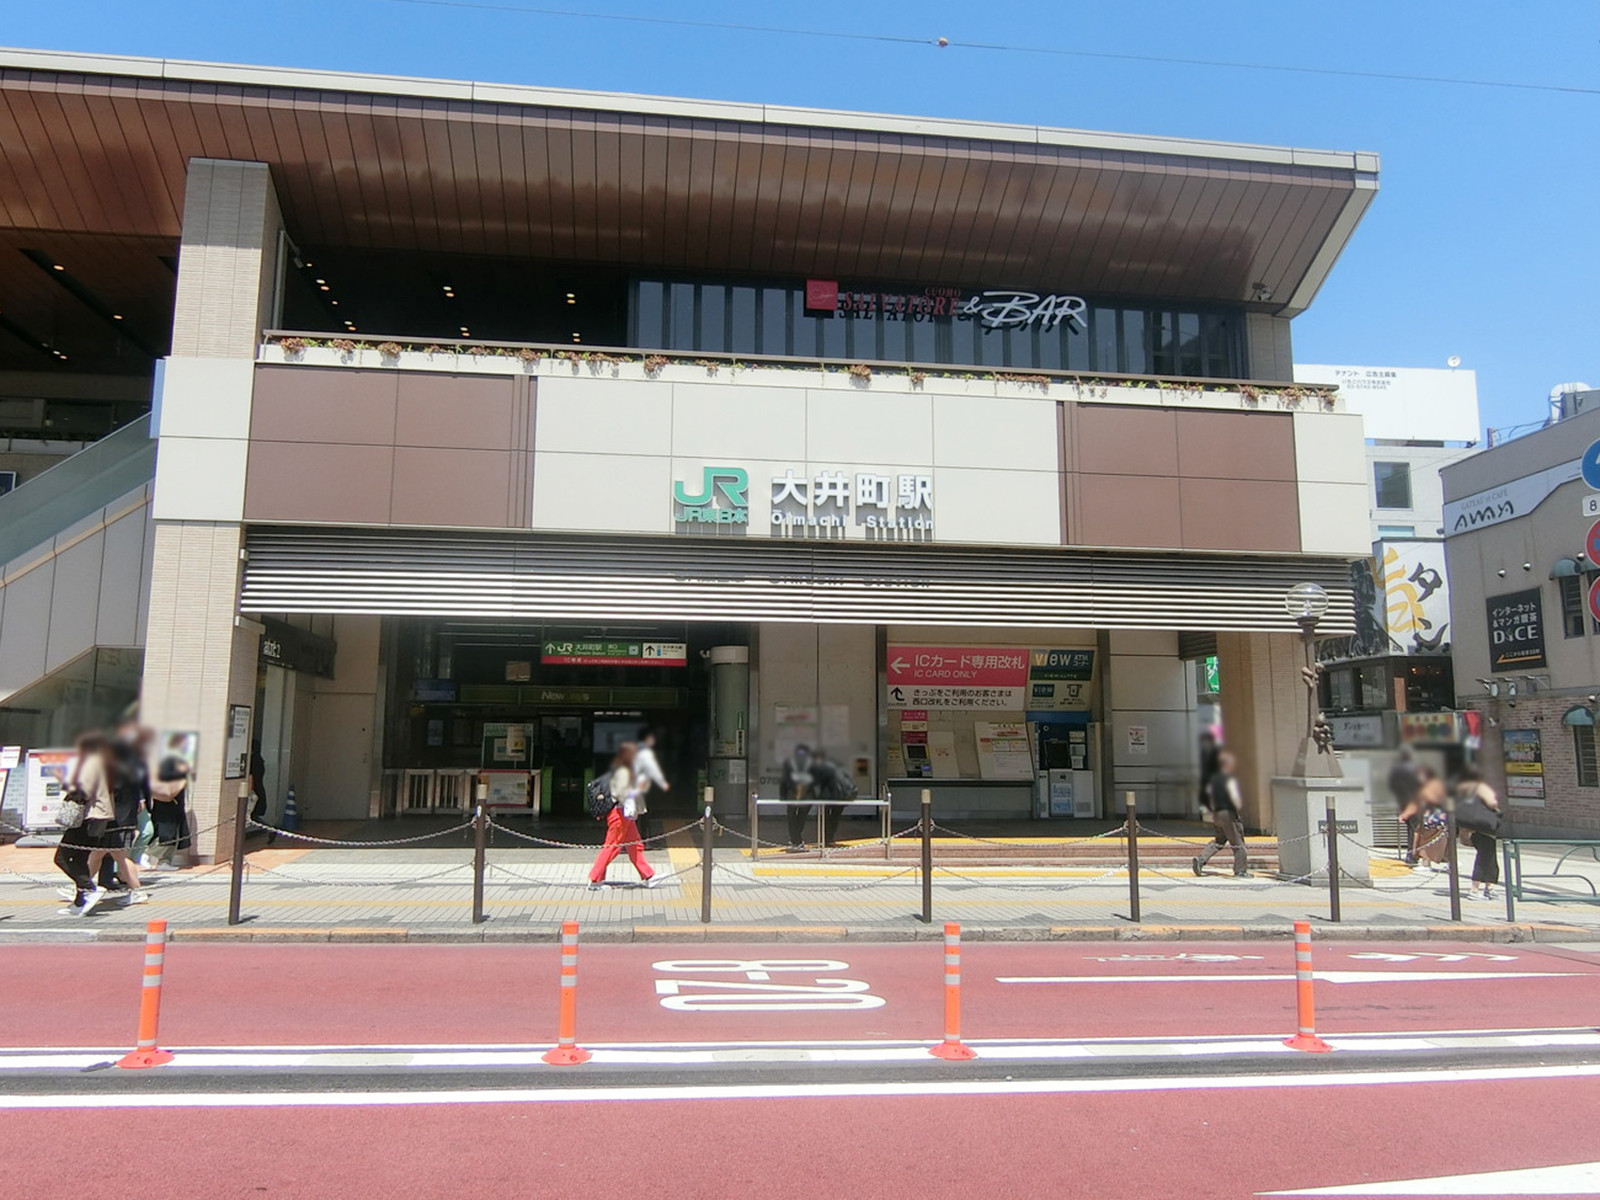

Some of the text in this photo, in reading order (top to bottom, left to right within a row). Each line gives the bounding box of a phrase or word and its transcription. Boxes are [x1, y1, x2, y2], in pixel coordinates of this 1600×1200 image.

[924, 286, 962, 298] CUOMO
[843, 291, 959, 316] SALVATORE
[982, 291, 1088, 327] BAR
[673, 466, 749, 507] JR
[770, 469, 933, 511] 大井町駅
[674, 506, 748, 524] JR東日本
[866, 513, 934, 529] Station
[1492, 602, 1536, 618] インターネット
[557, 643, 573, 652] JR
[914, 654, 1025, 669] ICカード専用改札
[914, 669, 977, 678] IC CARD ONLY
[913, 688, 1012, 699] きっぷをご利用のお客さまは
[912, 697, 1008, 707] 西口改札をご利用ください。
